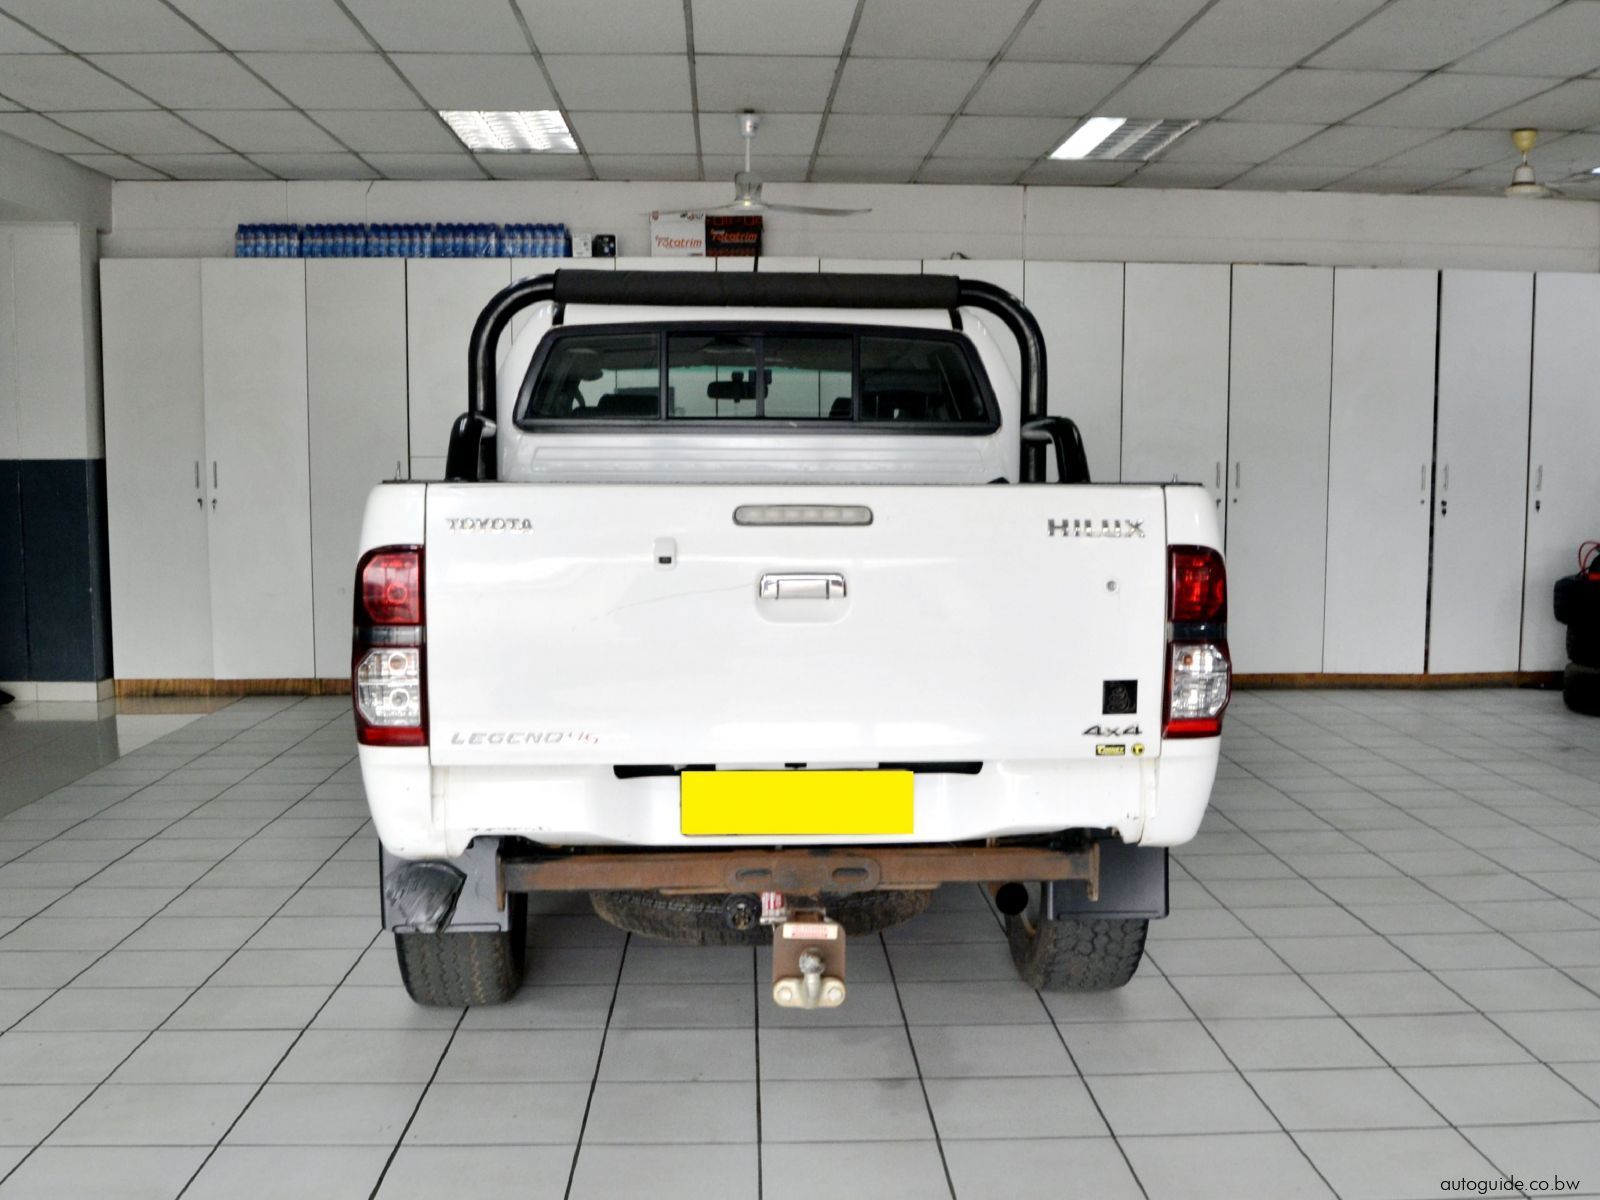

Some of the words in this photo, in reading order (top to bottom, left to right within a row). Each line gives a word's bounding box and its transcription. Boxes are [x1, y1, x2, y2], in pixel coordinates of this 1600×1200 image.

[446, 518, 533, 532] TOYOTA
[1048, 518, 1145, 537] HILUX
[451, 731, 564, 745] LEGEND
